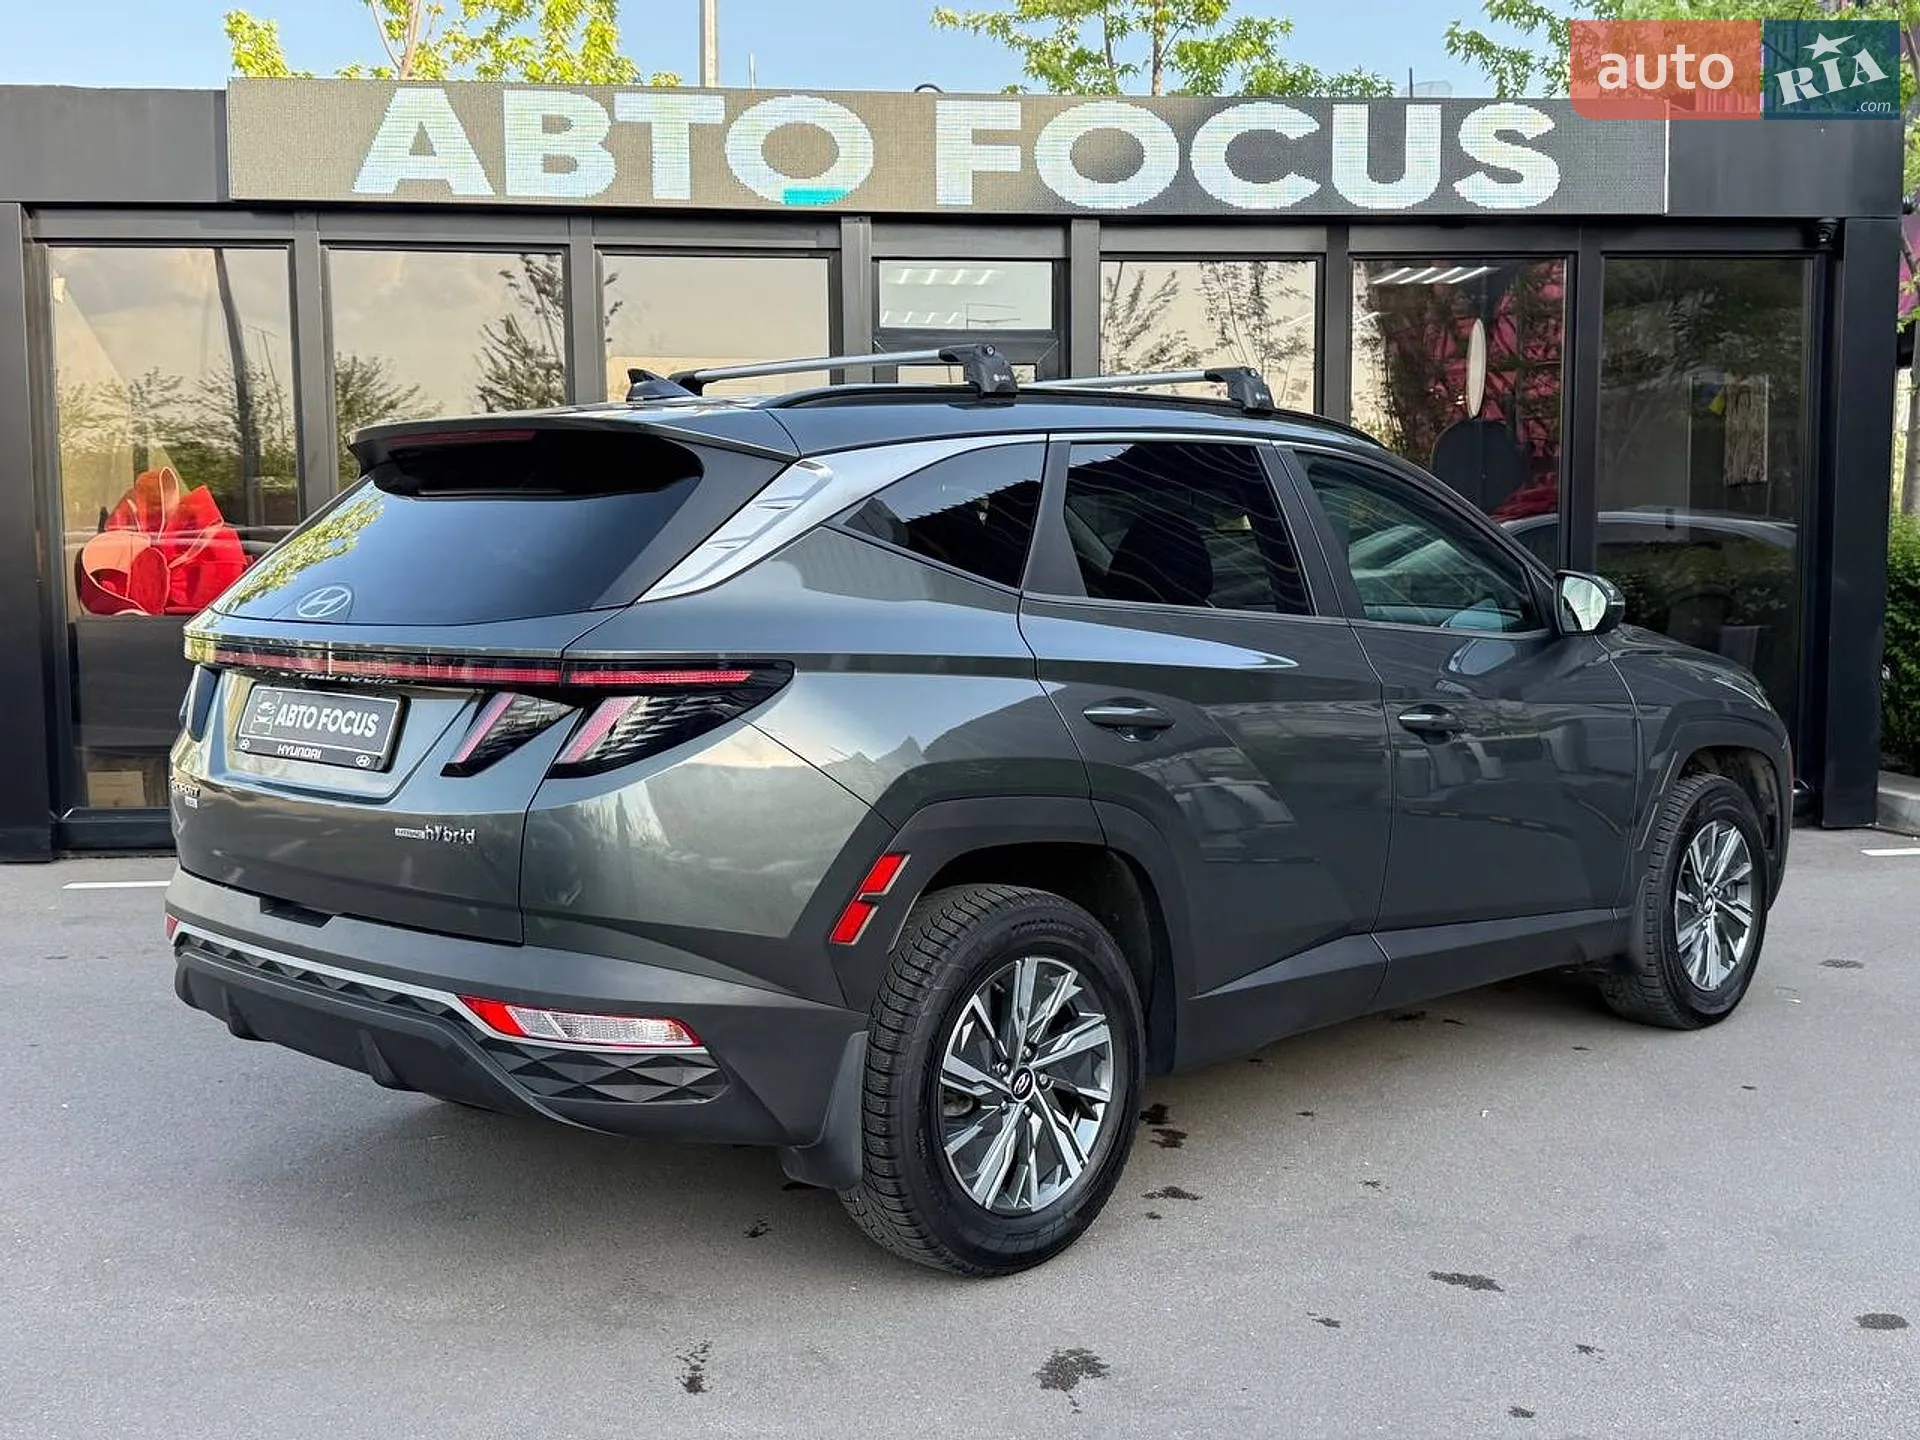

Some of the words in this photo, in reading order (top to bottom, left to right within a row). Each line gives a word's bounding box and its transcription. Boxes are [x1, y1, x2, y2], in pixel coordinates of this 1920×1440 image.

[352, 88, 874, 206] АВТО
[935, 100, 1561, 210] FOCUS
[274, 704, 317, 729] АВТО
[317, 707, 379, 738] FOCUS
[276, 744, 322, 760] HYUNDAI
